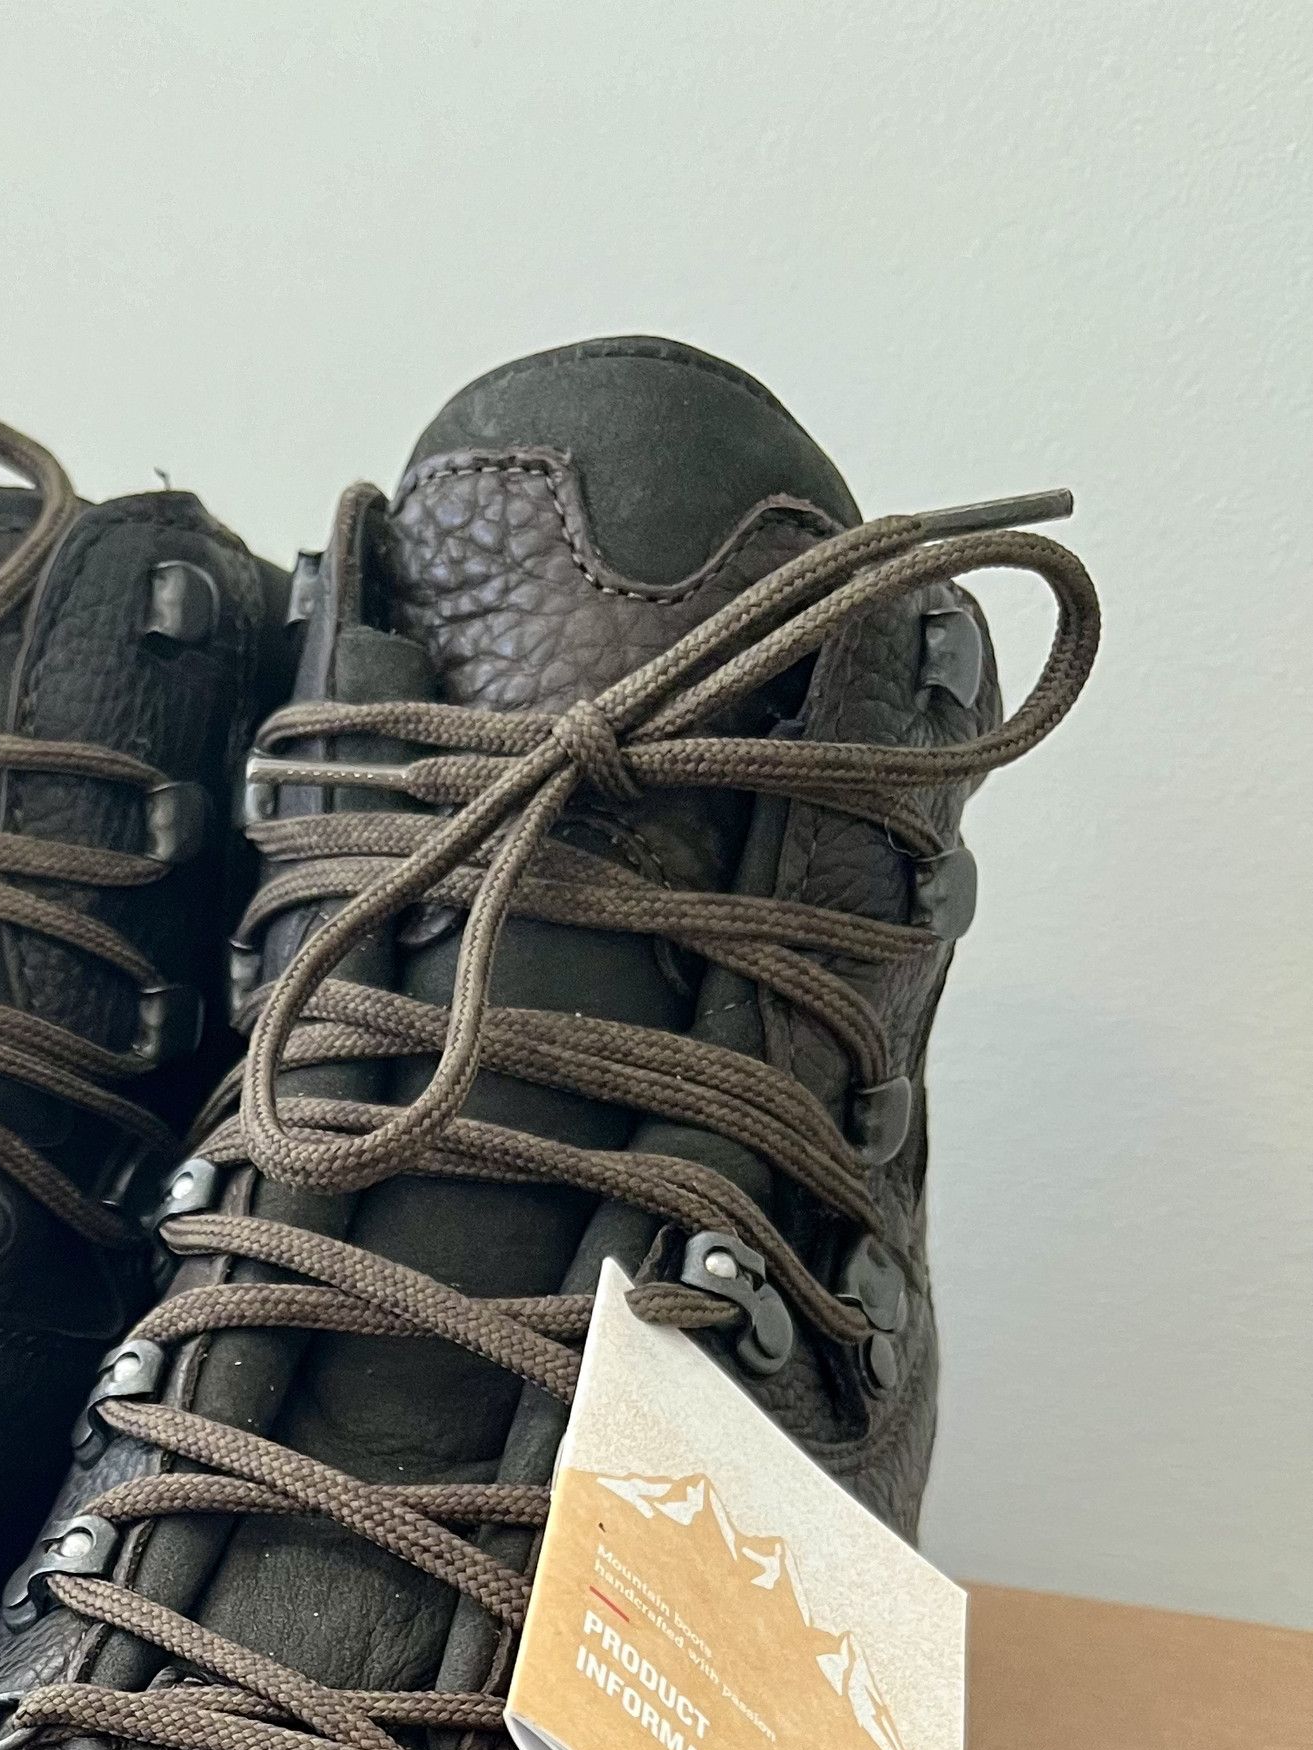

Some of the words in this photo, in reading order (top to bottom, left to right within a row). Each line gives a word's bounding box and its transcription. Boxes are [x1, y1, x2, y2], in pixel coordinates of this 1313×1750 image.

[594, 1559, 684, 1649] handcrafted
[688, 1648, 720, 1684] with
[597, 1543, 670, 1616] Mountain
[674, 1611, 713, 1658] boots
[583, 1609, 710, 1739] PRODUCT
